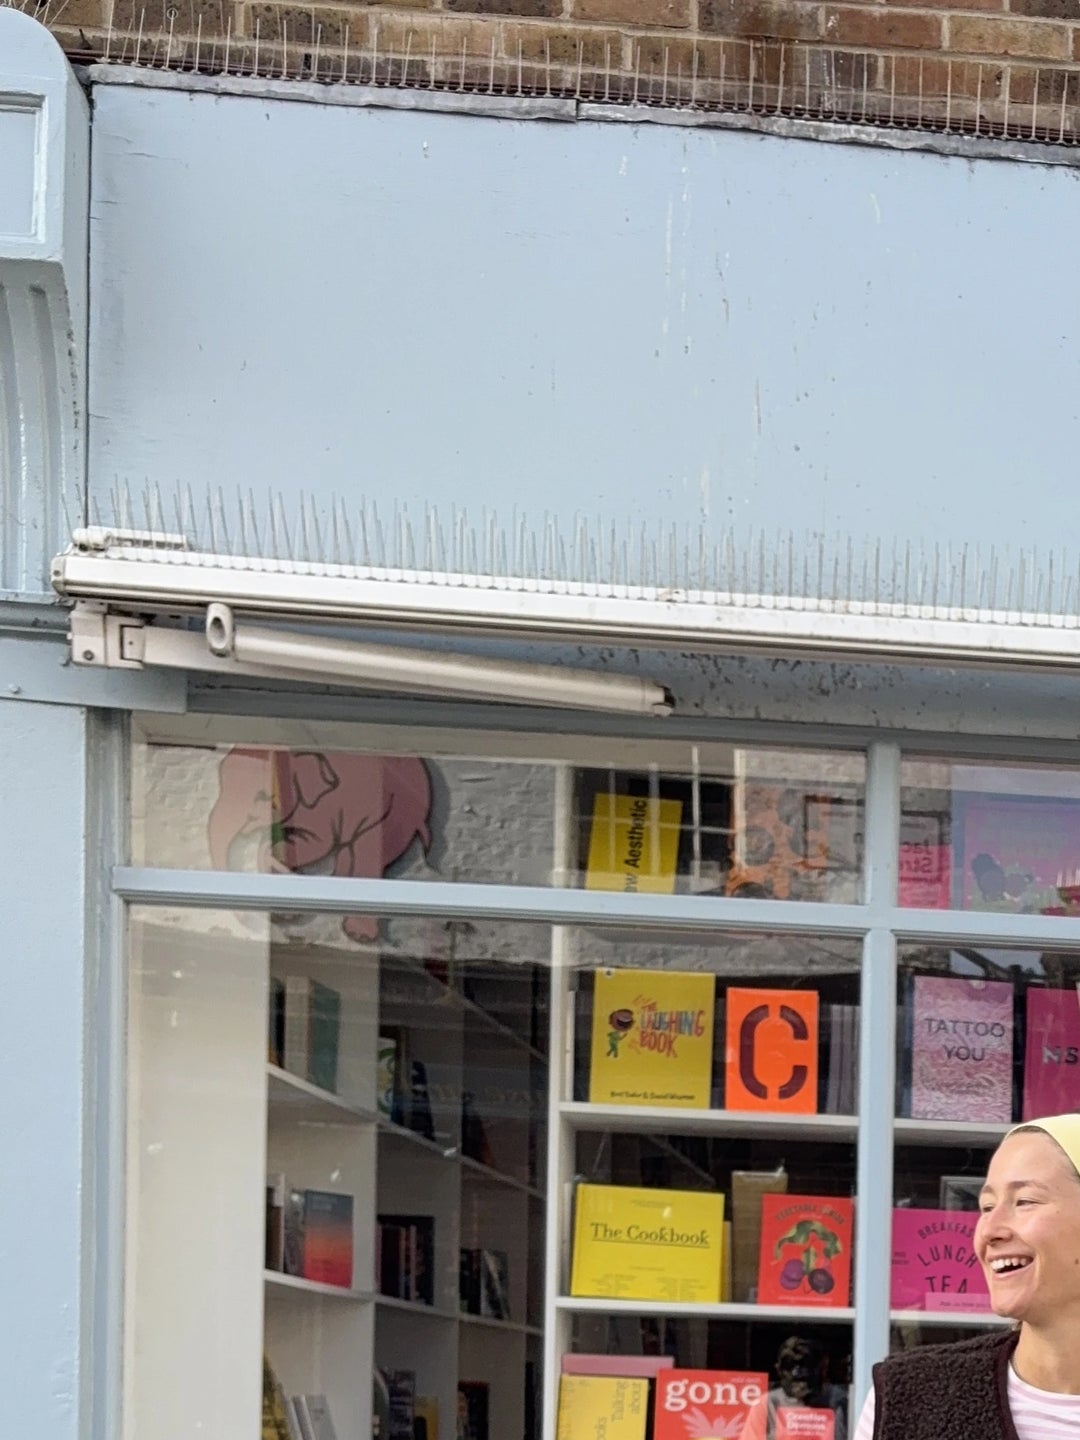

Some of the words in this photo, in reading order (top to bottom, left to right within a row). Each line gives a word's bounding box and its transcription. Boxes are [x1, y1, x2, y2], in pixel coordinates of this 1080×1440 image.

[623, 800, 648, 869] Aesthetic
[925, 1018, 1005, 1037] TATTOO
[640, 1030, 677, 1058] BOOK
[740, 1004, 808, 1100] C
[942, 1044, 986, 1061] YOU
[590, 1222, 622, 1238] The
[627, 1225, 709, 1245] Cookbook
[918, 1222, 975, 1240] BREAKFAS
[917, 1244, 979, 1268] LUNCH
[664, 1379, 762, 1412] gone
